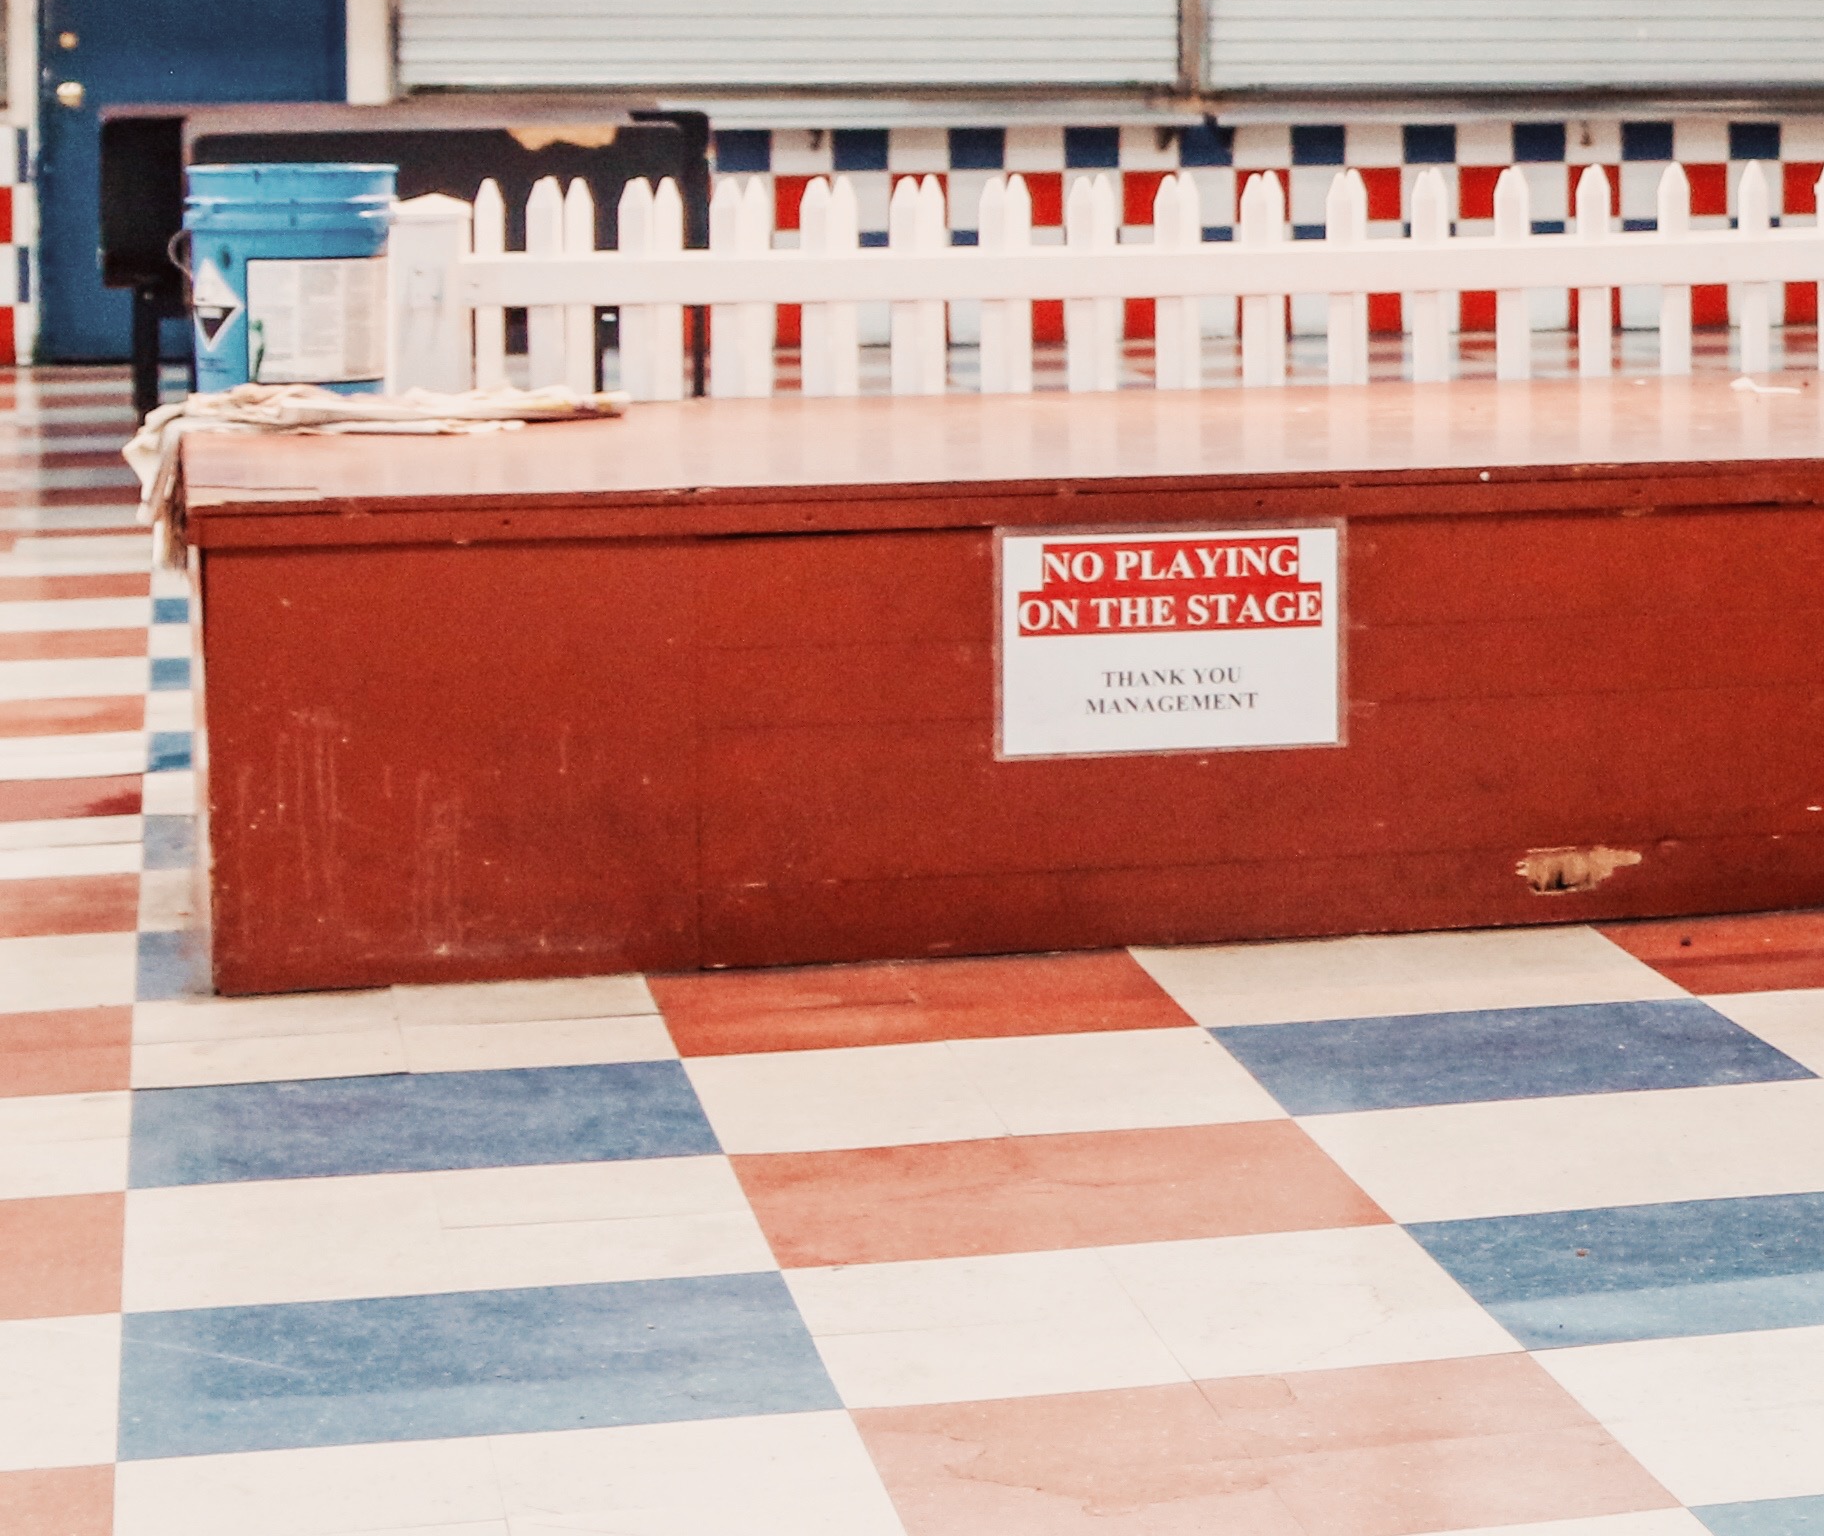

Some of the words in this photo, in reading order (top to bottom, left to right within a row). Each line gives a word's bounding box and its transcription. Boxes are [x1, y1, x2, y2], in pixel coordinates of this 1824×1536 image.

[1042, 550, 1105, 584] NO
[1114, 544, 1299, 582] PLAYING
[1018, 598, 1079, 632] ON
[1090, 594, 1176, 629] THE
[1186, 590, 1322, 626] STAGE
[1101, 668, 1187, 689] THANK
[1192, 666, 1243, 686] YOU
[1084, 691, 1260, 716] MANAGEMENT
